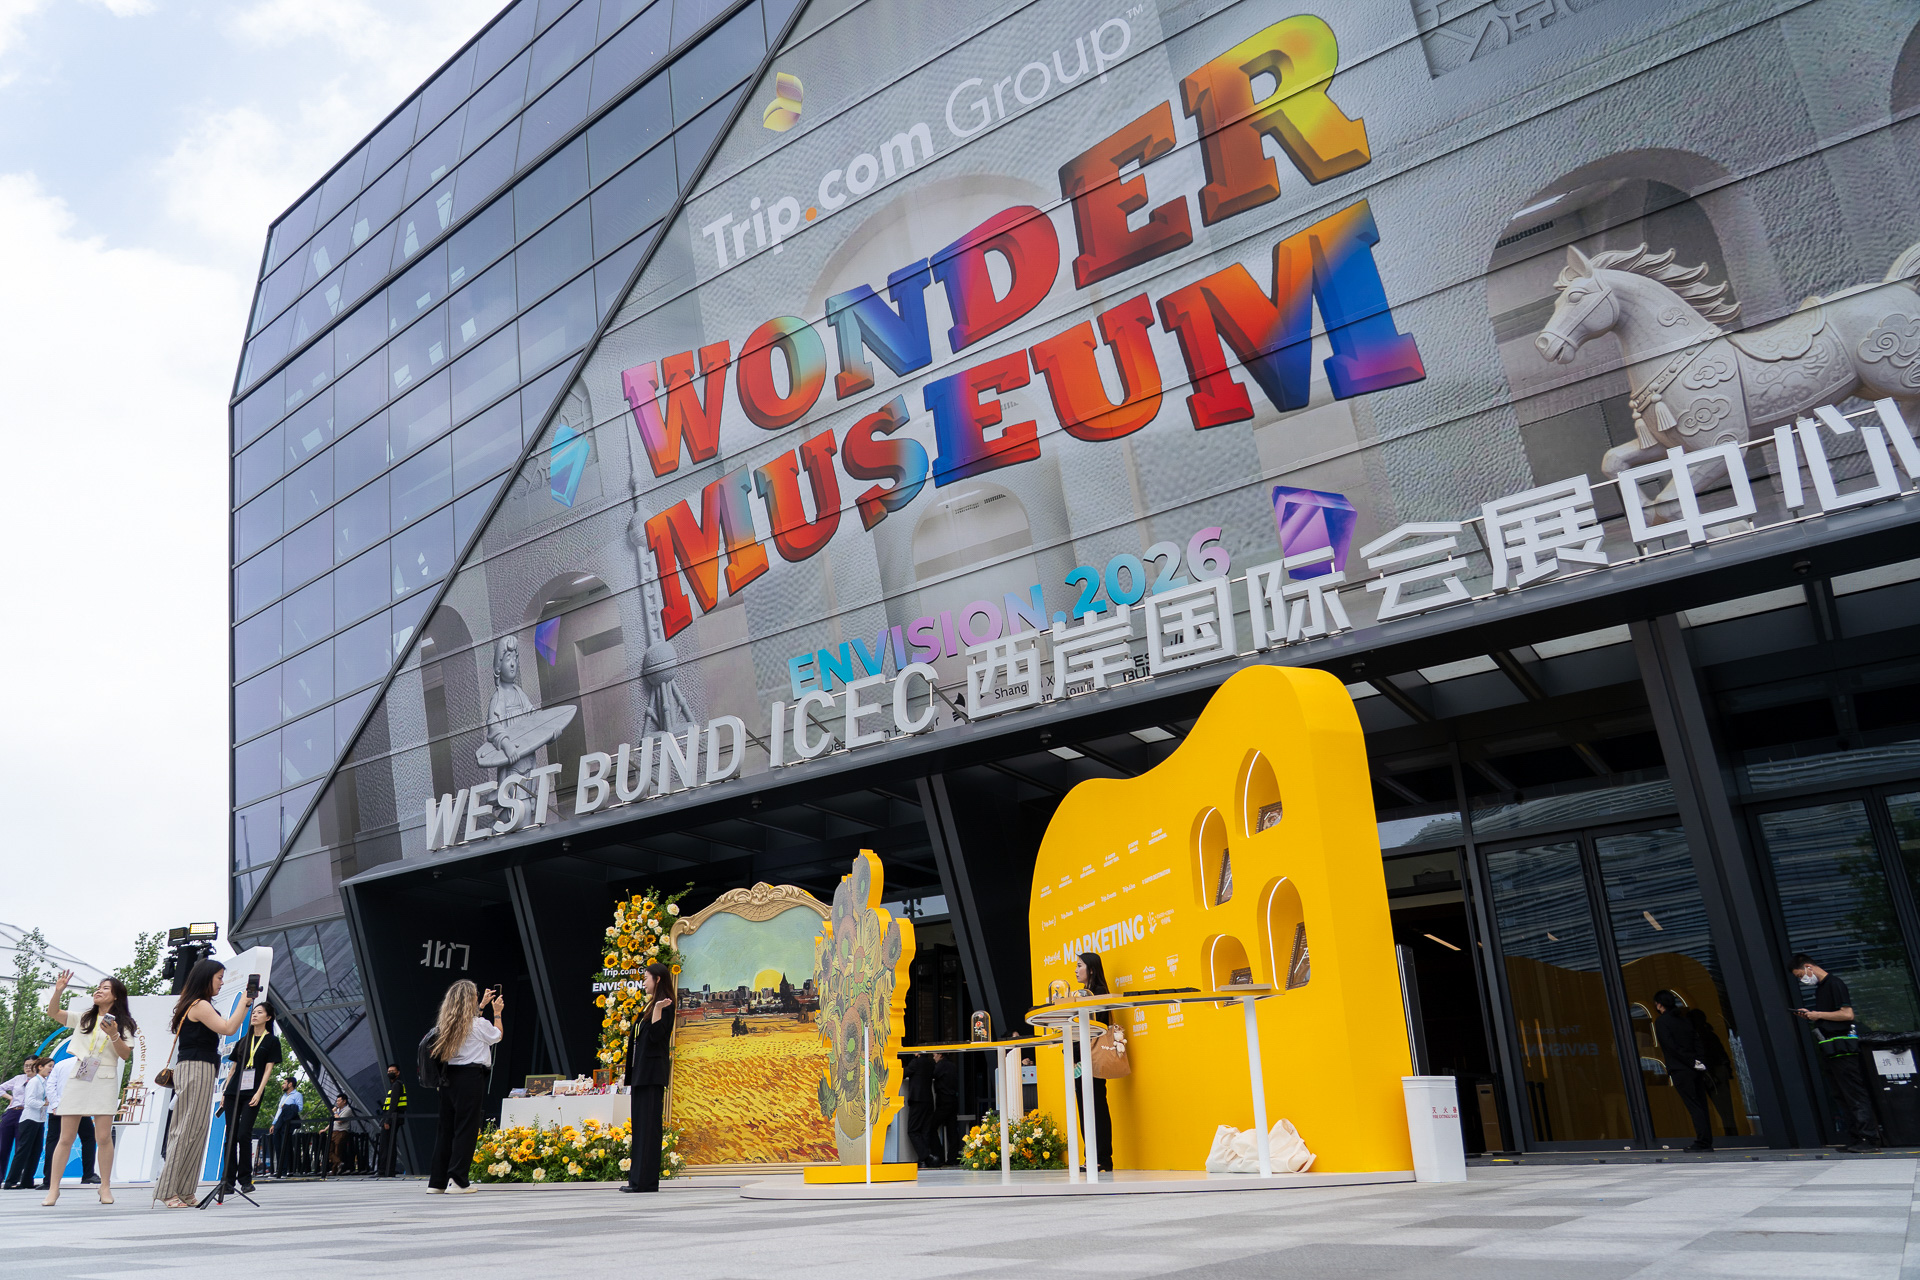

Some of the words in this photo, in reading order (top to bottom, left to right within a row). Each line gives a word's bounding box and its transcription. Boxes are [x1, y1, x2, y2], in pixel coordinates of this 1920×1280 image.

[622, 13, 1372, 478] WONDER
[703, 121, 935, 269] Trip.com
[644, 199, 1426, 641] MUSEUM
[425, 762, 563, 851] WEST
[576, 714, 747, 814] BUND
[770, 661, 940, 768] ICEC
[966, 397, 1920, 722] 西岸国际会展中心
[788, 526, 1231, 699] ENVISION.2026
[420, 939, 471, 971] 北门
[1063, 914, 1145, 965] MARKETING
[138, 1035, 147, 1062] Gather
